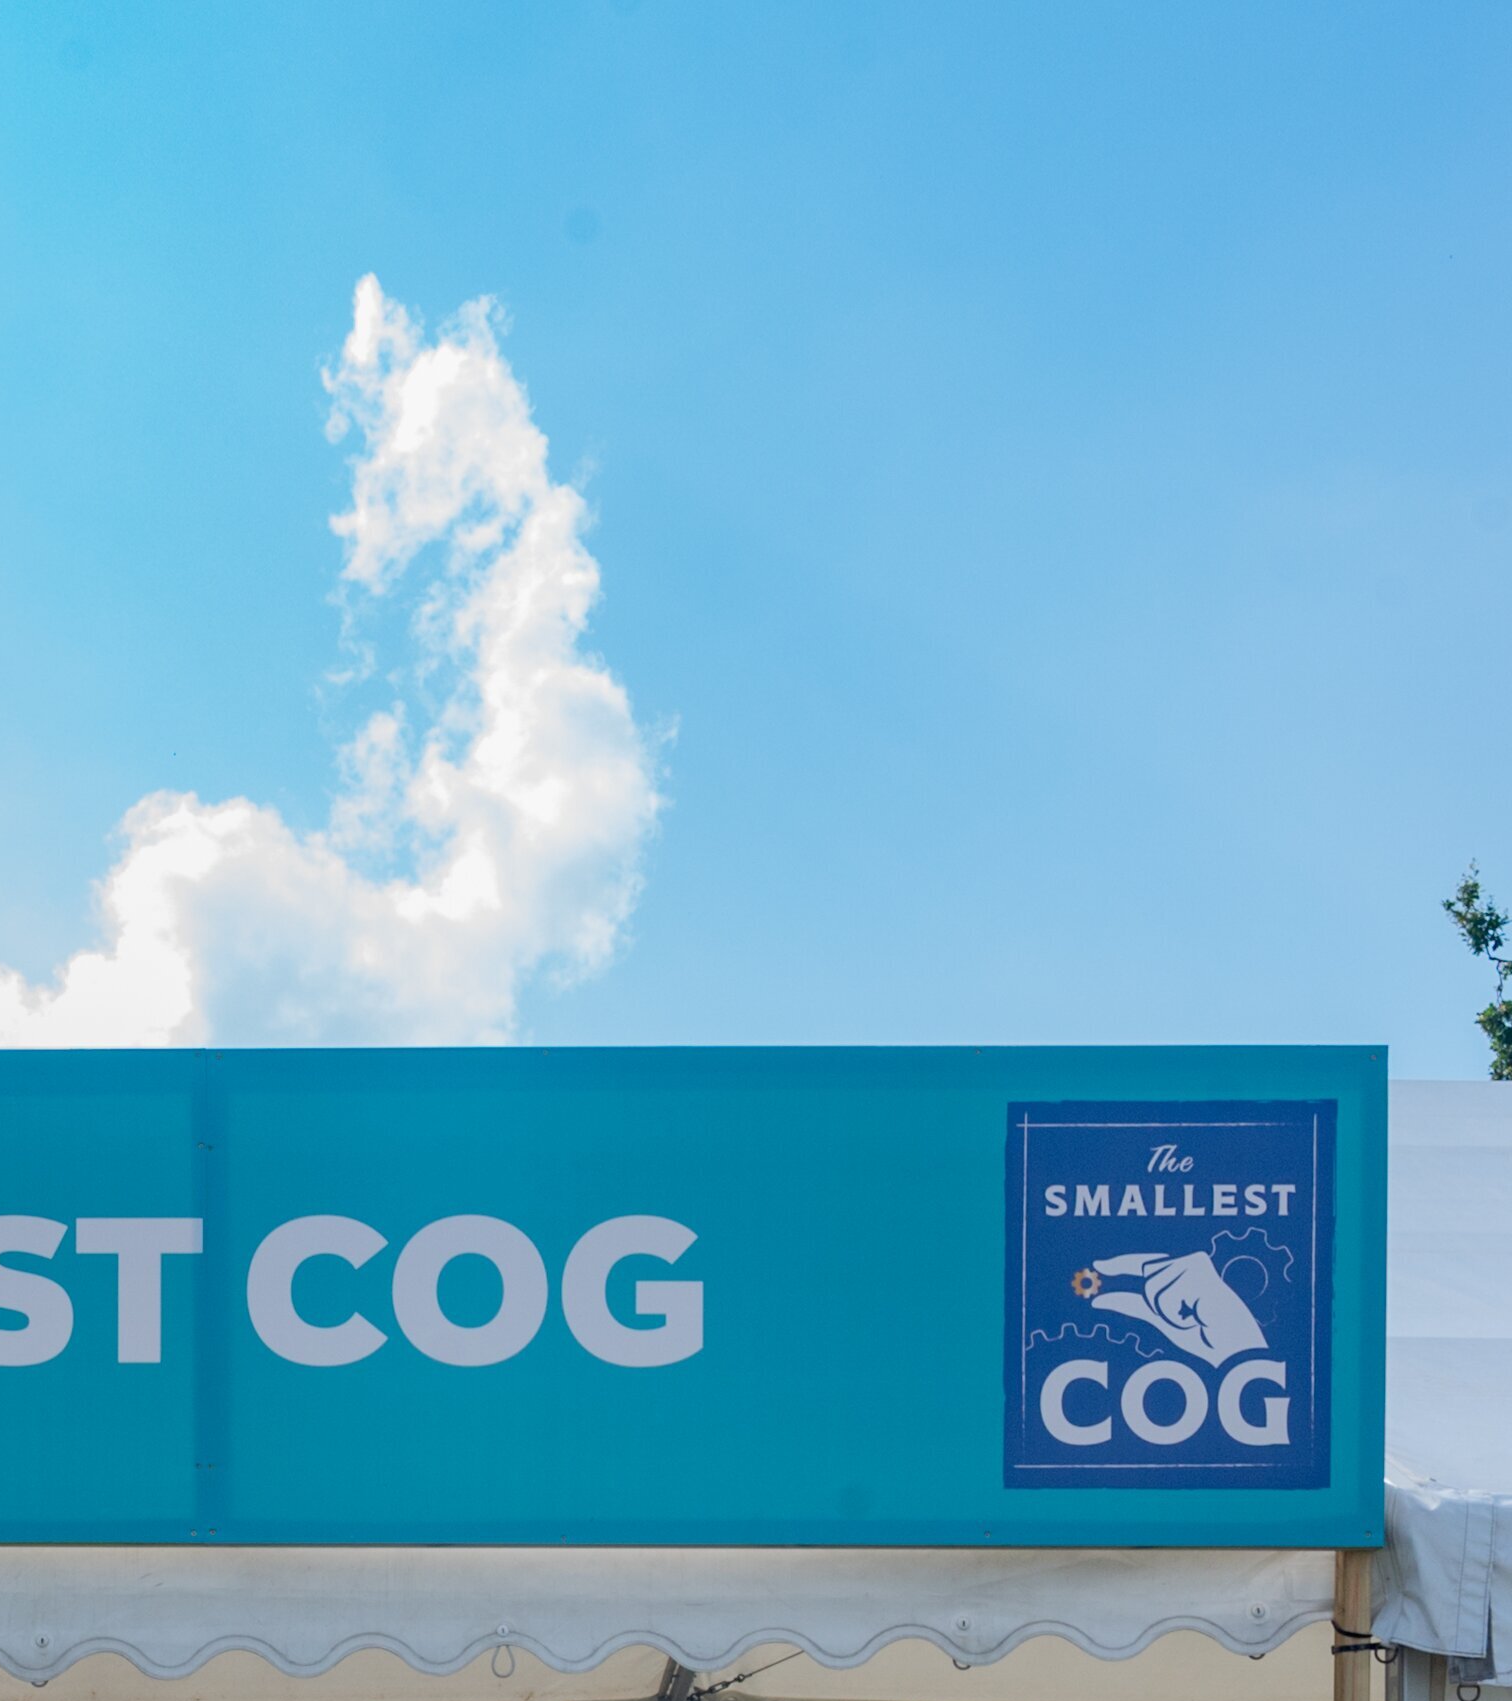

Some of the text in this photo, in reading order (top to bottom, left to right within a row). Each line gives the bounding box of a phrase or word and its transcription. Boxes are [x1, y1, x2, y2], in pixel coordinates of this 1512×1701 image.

[1145, 1143, 1195, 1173] The
[1044, 1183, 1297, 1217] SMALLEST
[245, 1215, 705, 1365] COG
[1039, 1358, 1291, 1447] COG
